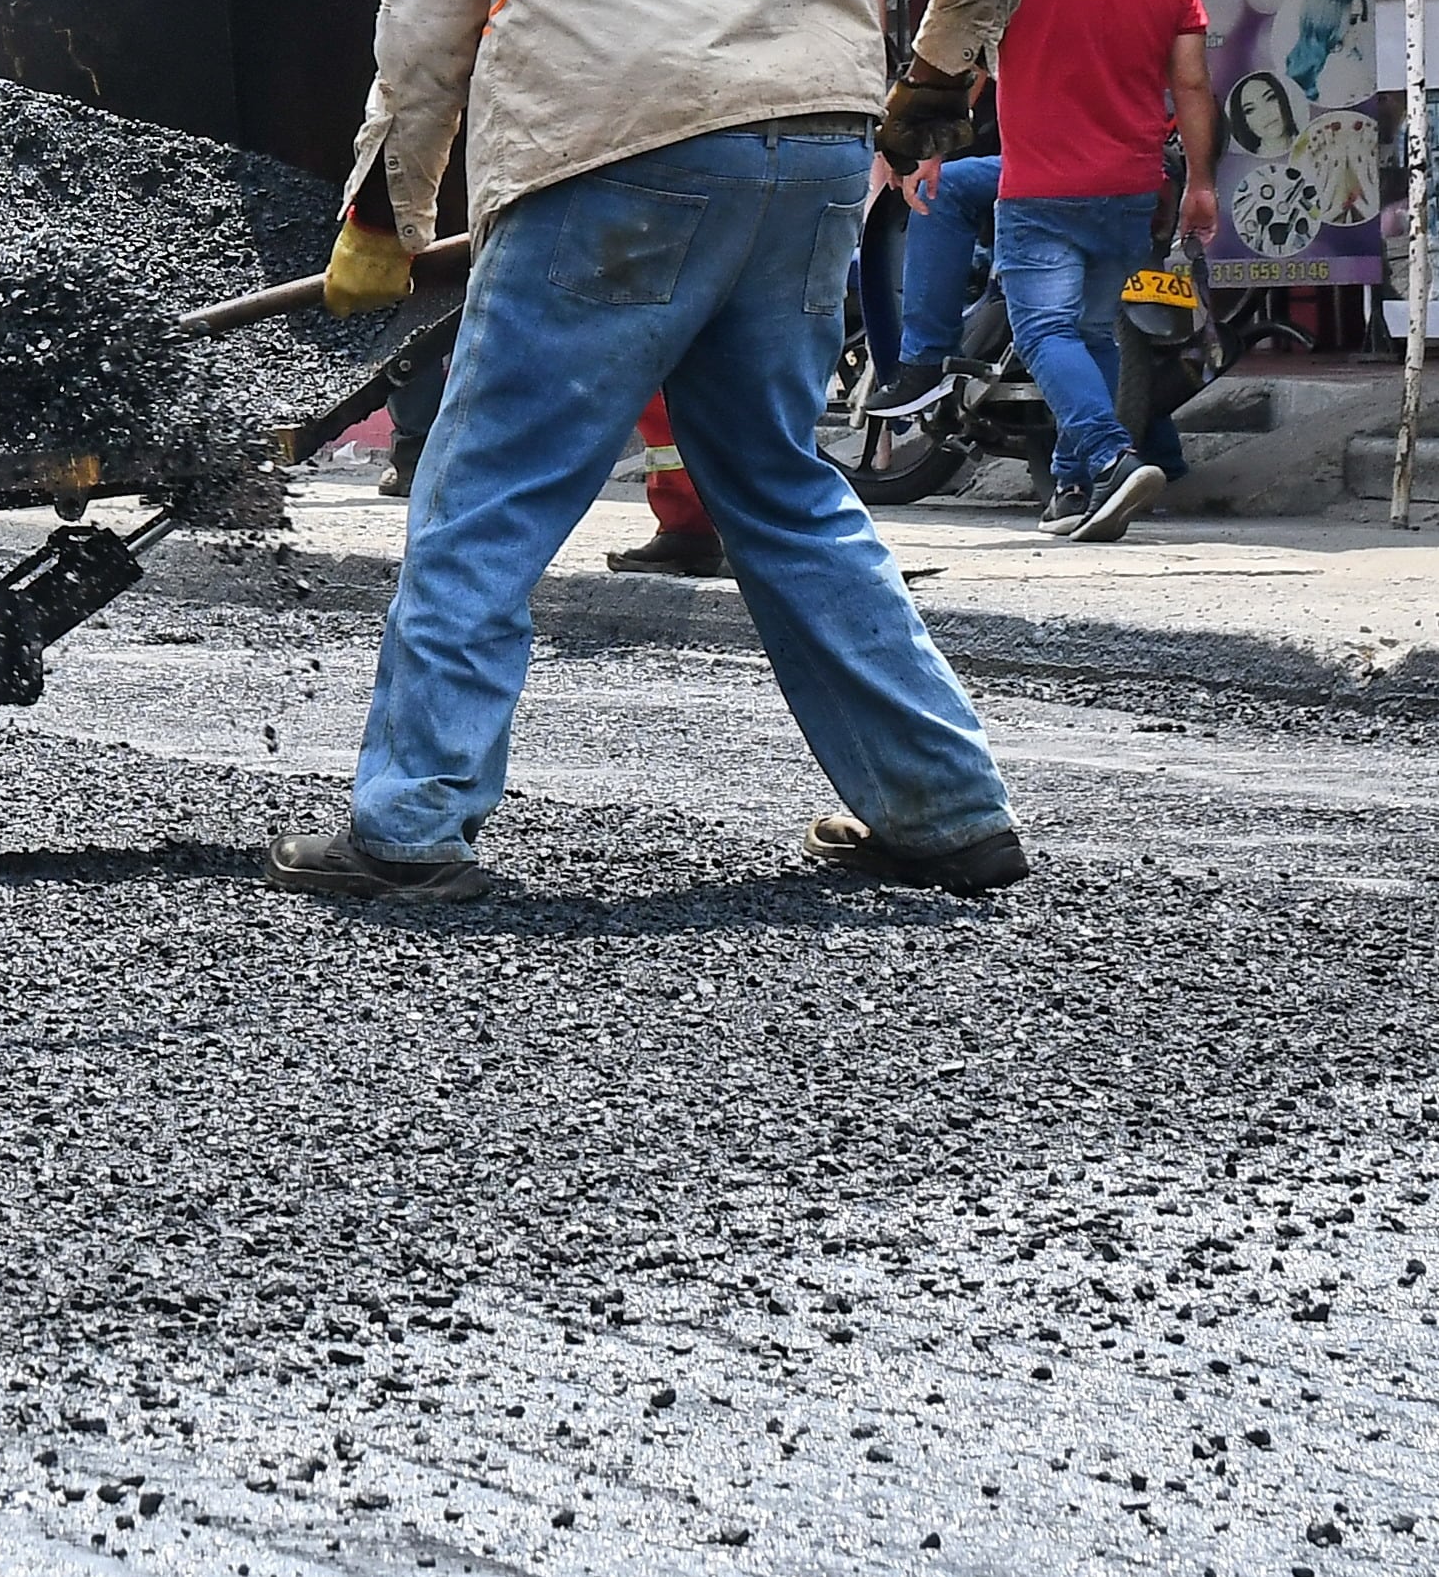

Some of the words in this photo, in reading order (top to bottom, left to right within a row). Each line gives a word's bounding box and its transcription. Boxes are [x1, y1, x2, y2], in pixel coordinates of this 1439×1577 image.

[1212, 263, 1243, 281] 315
[1249, 262, 1281, 280] 659
[1287, 261, 1329, 280] 3146
